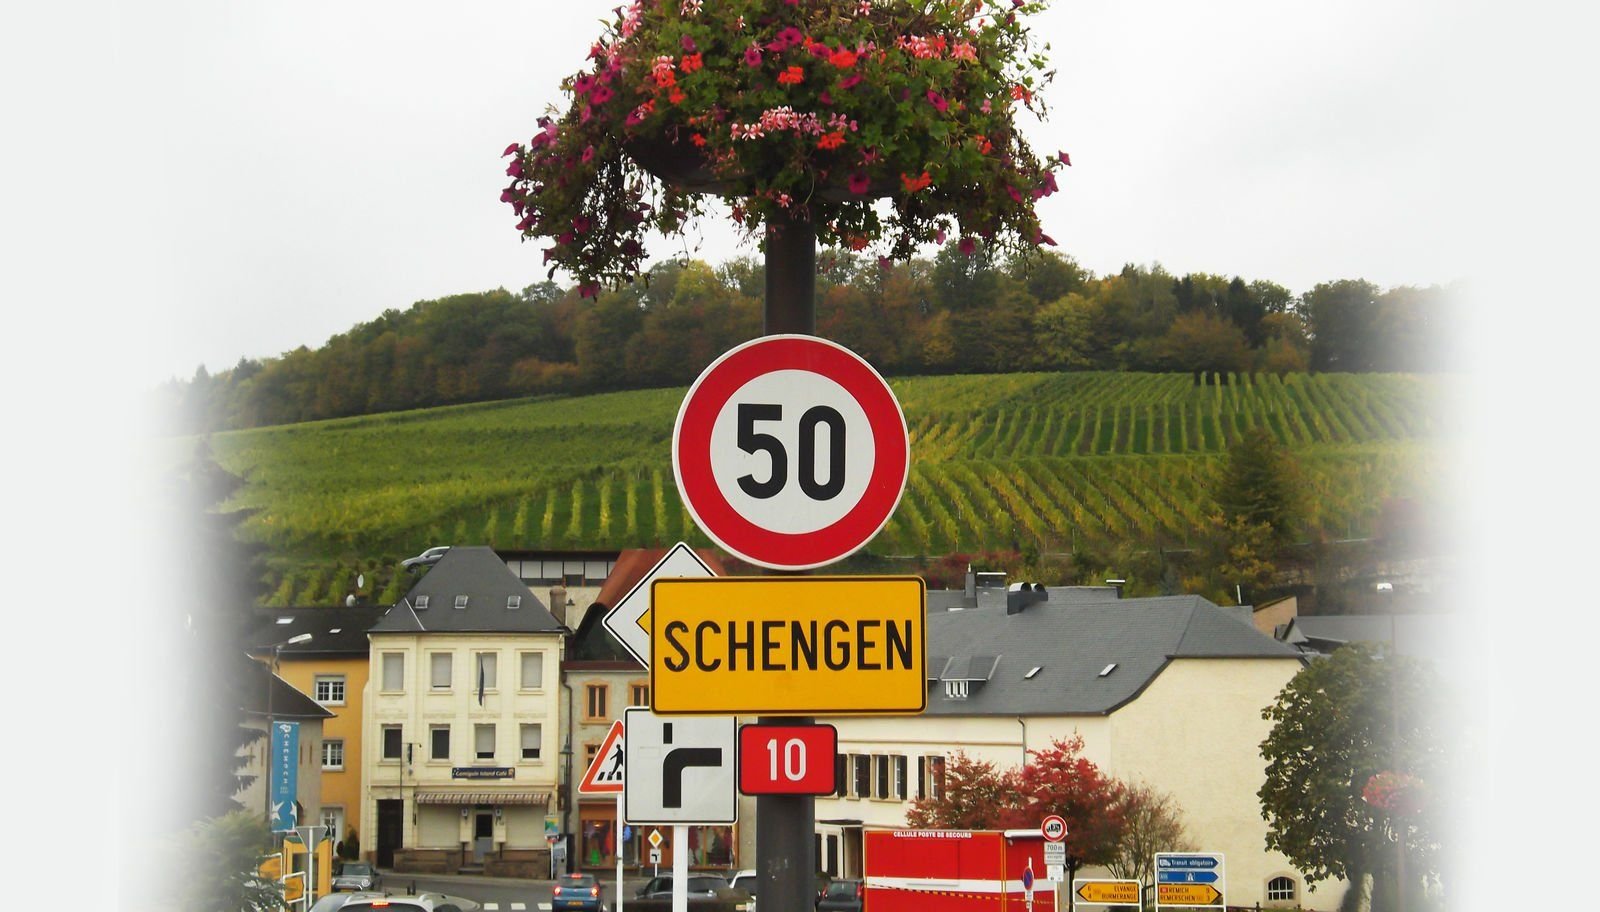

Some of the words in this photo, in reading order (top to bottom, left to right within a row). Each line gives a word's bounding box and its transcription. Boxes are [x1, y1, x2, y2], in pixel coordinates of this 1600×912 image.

[736, 403, 847, 501] 50
[663, 619, 913, 673] SCHENGEN
[766, 738, 807, 782] 10
[1189, 859, 1213, 868] obligatoire
